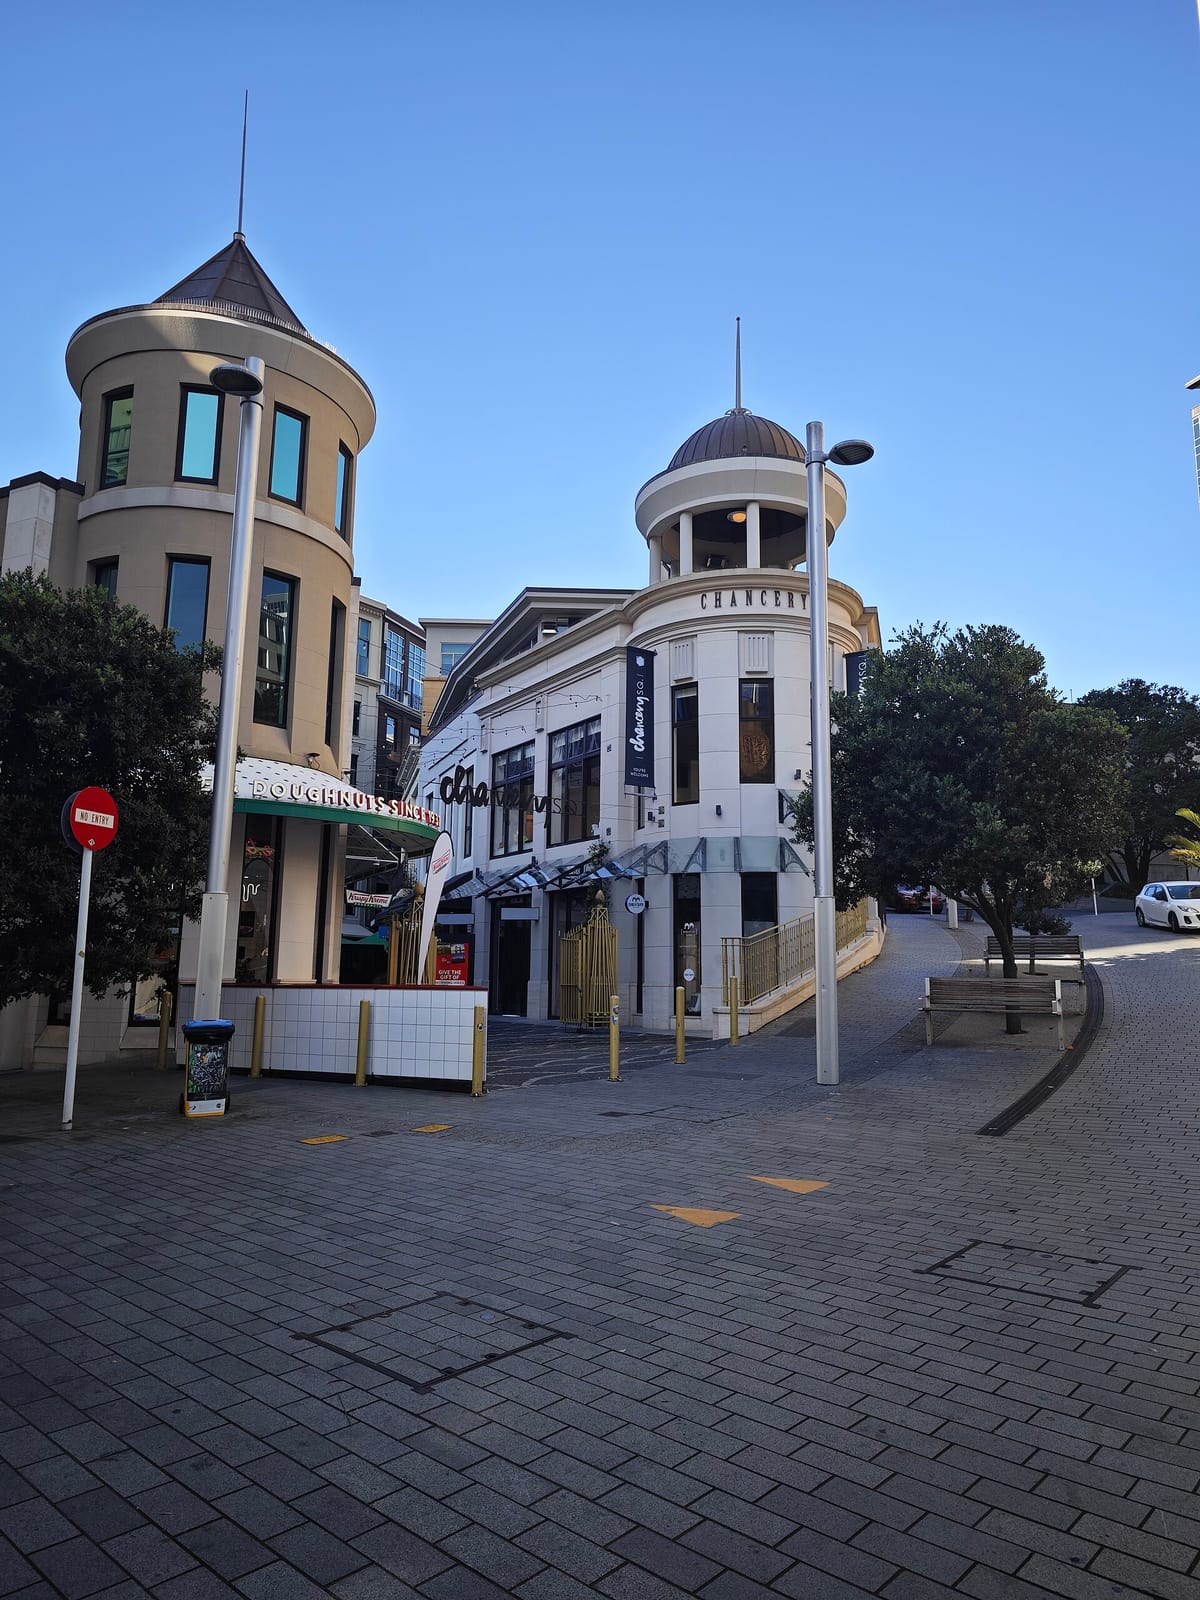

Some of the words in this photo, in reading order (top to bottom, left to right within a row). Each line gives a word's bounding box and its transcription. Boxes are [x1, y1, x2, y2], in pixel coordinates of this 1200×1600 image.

[701, 589, 808, 610] CHANCERY
[252, 780, 385, 812] DOUGHNUTS
[388, 799, 426, 821] SINCE
[80, 811, 88, 822] NO
[92, 813, 110, 825] ENTRY
